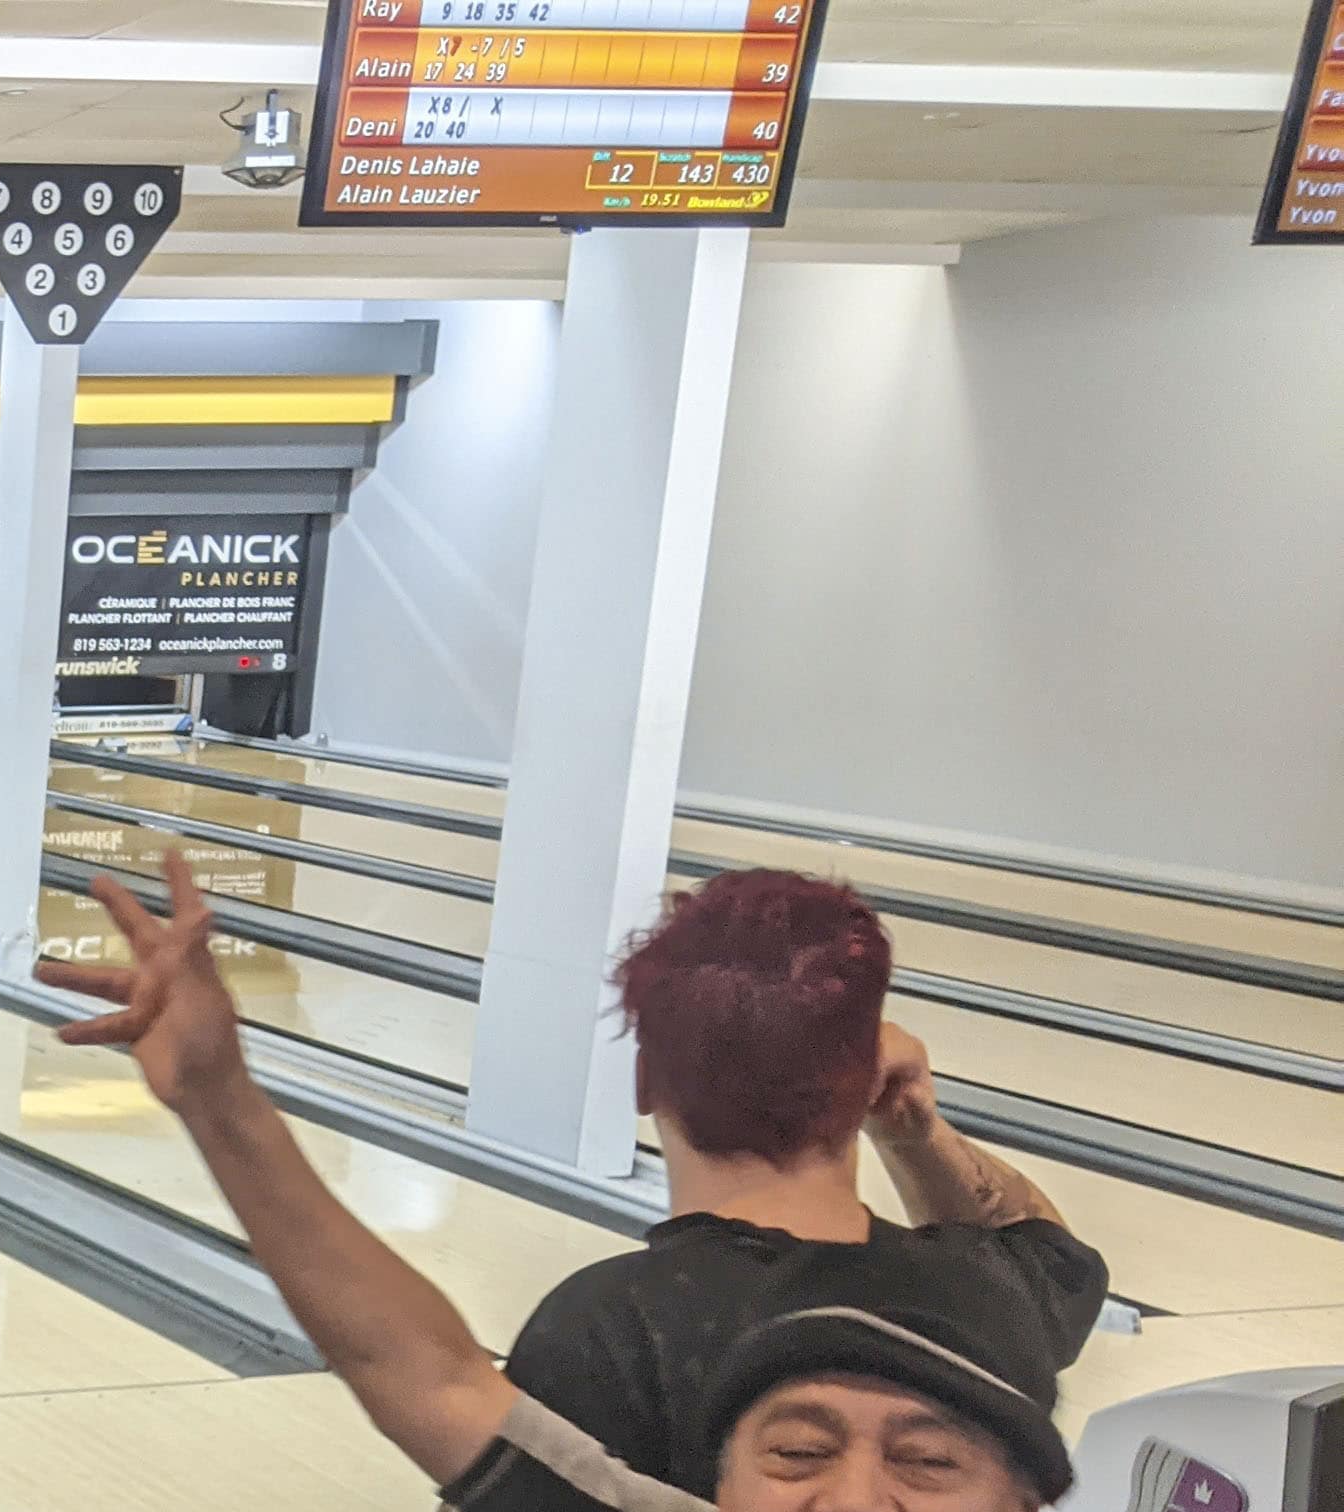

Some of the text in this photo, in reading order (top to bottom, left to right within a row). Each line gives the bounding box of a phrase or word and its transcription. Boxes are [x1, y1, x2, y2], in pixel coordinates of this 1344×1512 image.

[362, 1, 801, 25] Ray 9 18 35 42 42
[355, 58, 789, 83] Alain 17 24 39 39
[428, 97, 440, 114] X
[491, 97, 503, 115] X
[346, 118, 778, 140] Deni 20 40 40
[340, 156, 480, 175] Denis Lahaie
[609, 164, 770, 183] 12 143 430
[40, 188, 53, 209] 8
[91, 189, 105, 210] 9
[140, 190, 158, 211] 10
[337, 185, 481, 204] Alain Lauzier
[640, 193, 681, 206] 19.51
[1290, 206, 1337, 224] Yvon
[10, 229, 126, 250] 4 5 6
[34, 270, 97, 291] 2 3
[58, 310, 67, 331] 1
[72, 530, 300, 565] OCÉANICK
[180, 571, 299, 587] PLANCHER
[98, 595, 295, 609] CÉRAMIQUE PLANCHER DE BOIS FRANC
[68, 611, 294, 625] PLANCHER FLOTTANT PLANCHER CHAUFFANT
[73, 637, 284, 652] 819 563-1234 oceanickplancher.com
[271, 653, 287, 671] 8
